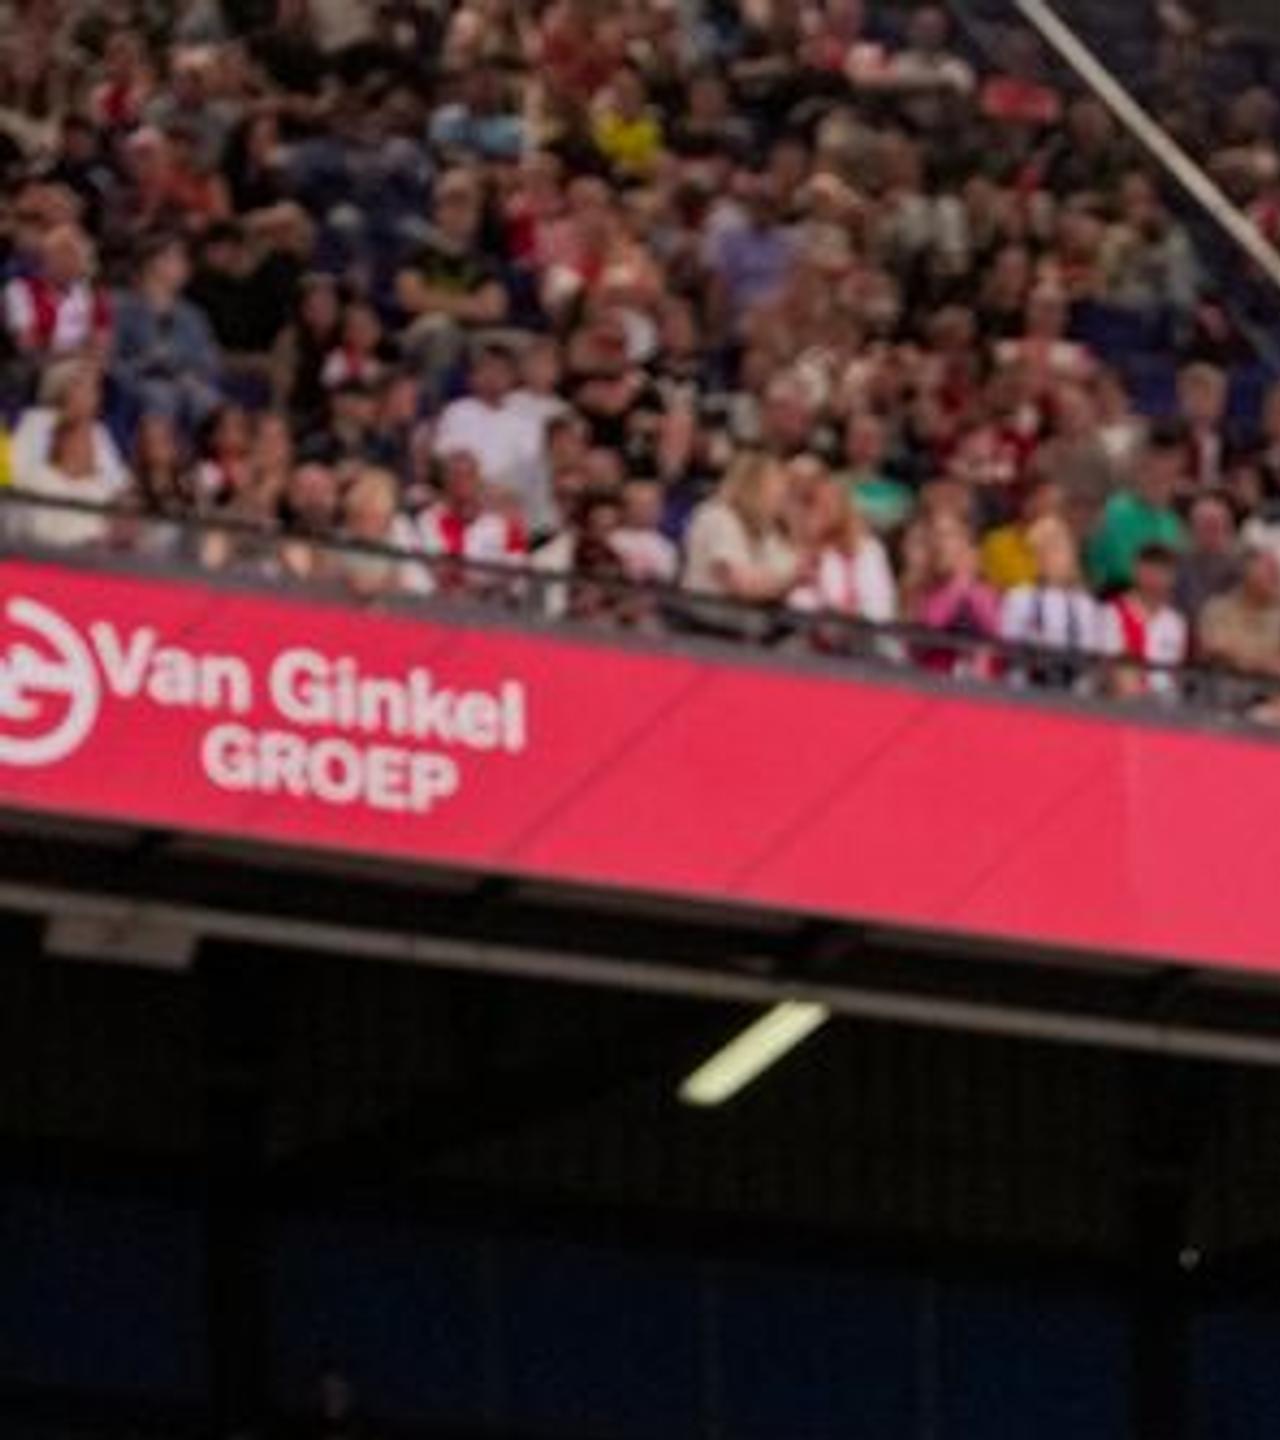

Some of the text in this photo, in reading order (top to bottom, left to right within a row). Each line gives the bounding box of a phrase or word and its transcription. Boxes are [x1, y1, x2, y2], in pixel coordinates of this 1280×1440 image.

[90, 619, 527, 753] Van Ginkel
[201, 722, 459, 814] GROEP
